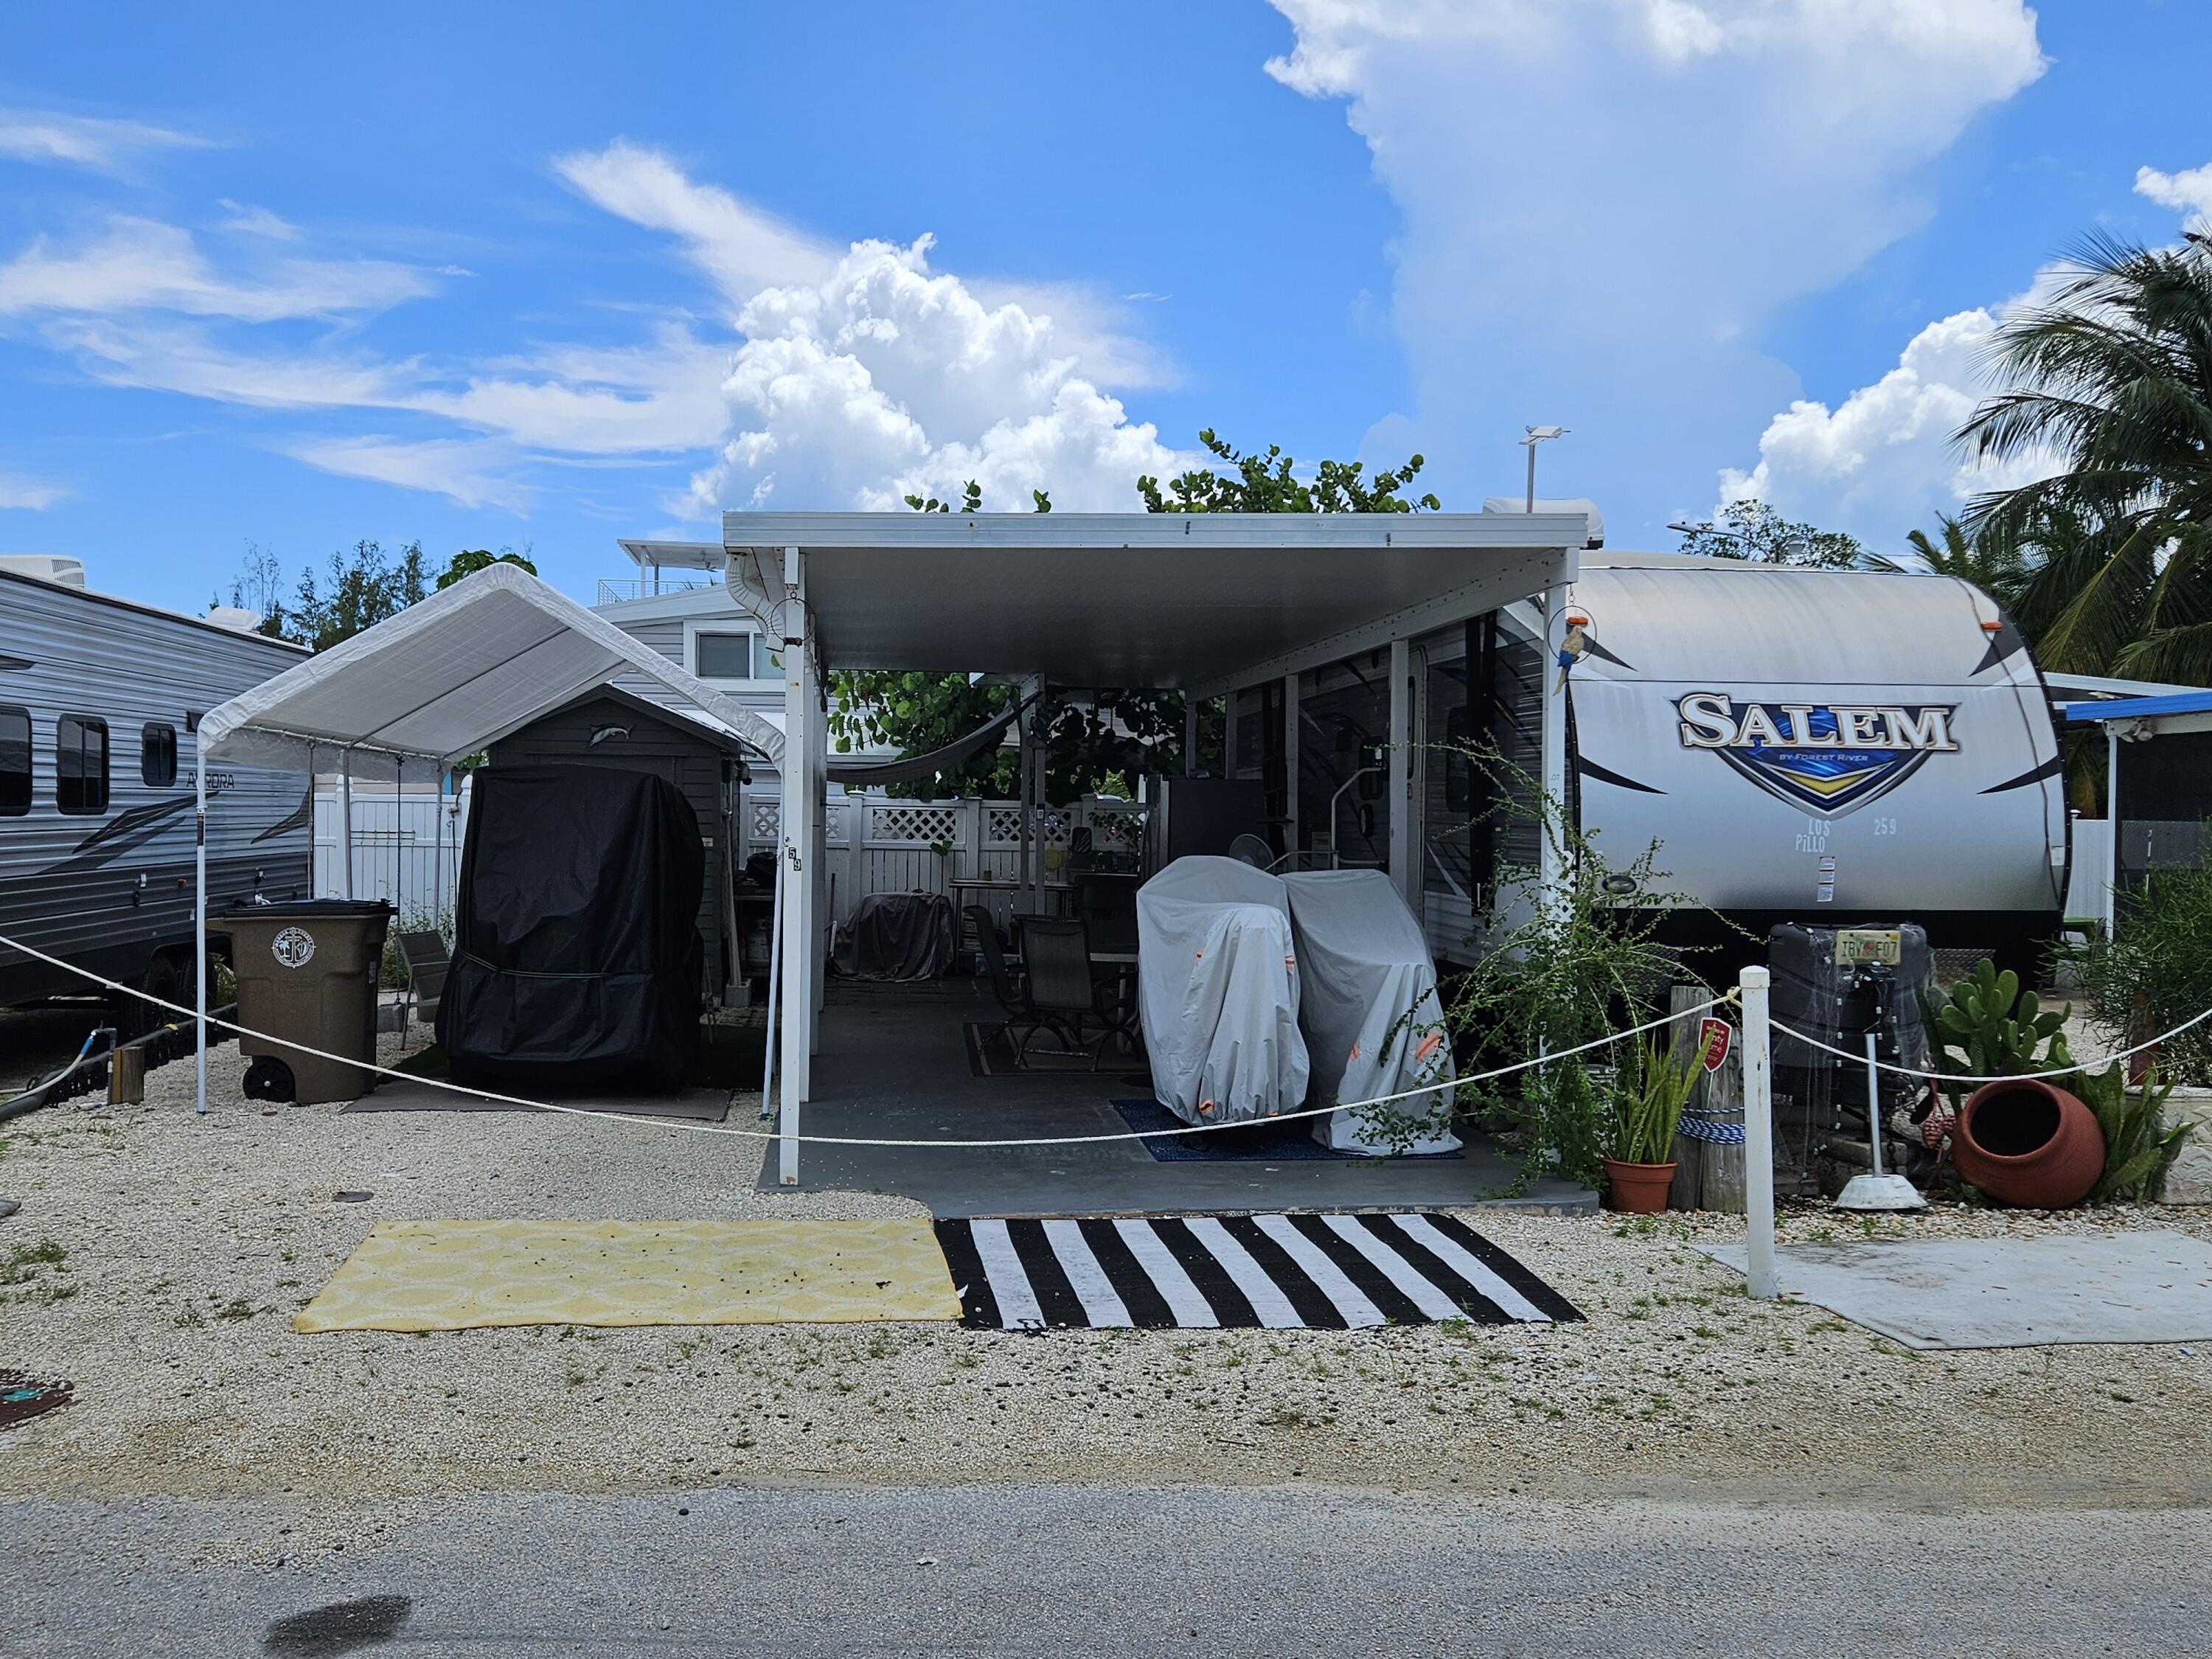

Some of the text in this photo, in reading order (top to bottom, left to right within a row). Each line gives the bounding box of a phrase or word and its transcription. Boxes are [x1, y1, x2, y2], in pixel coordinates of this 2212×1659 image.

[1678, 693, 1958, 750] SALEM
[187, 772, 234, 789] ARORA
[1808, 818, 1831, 837] LOS
[1874, 817, 1897, 835] 259
